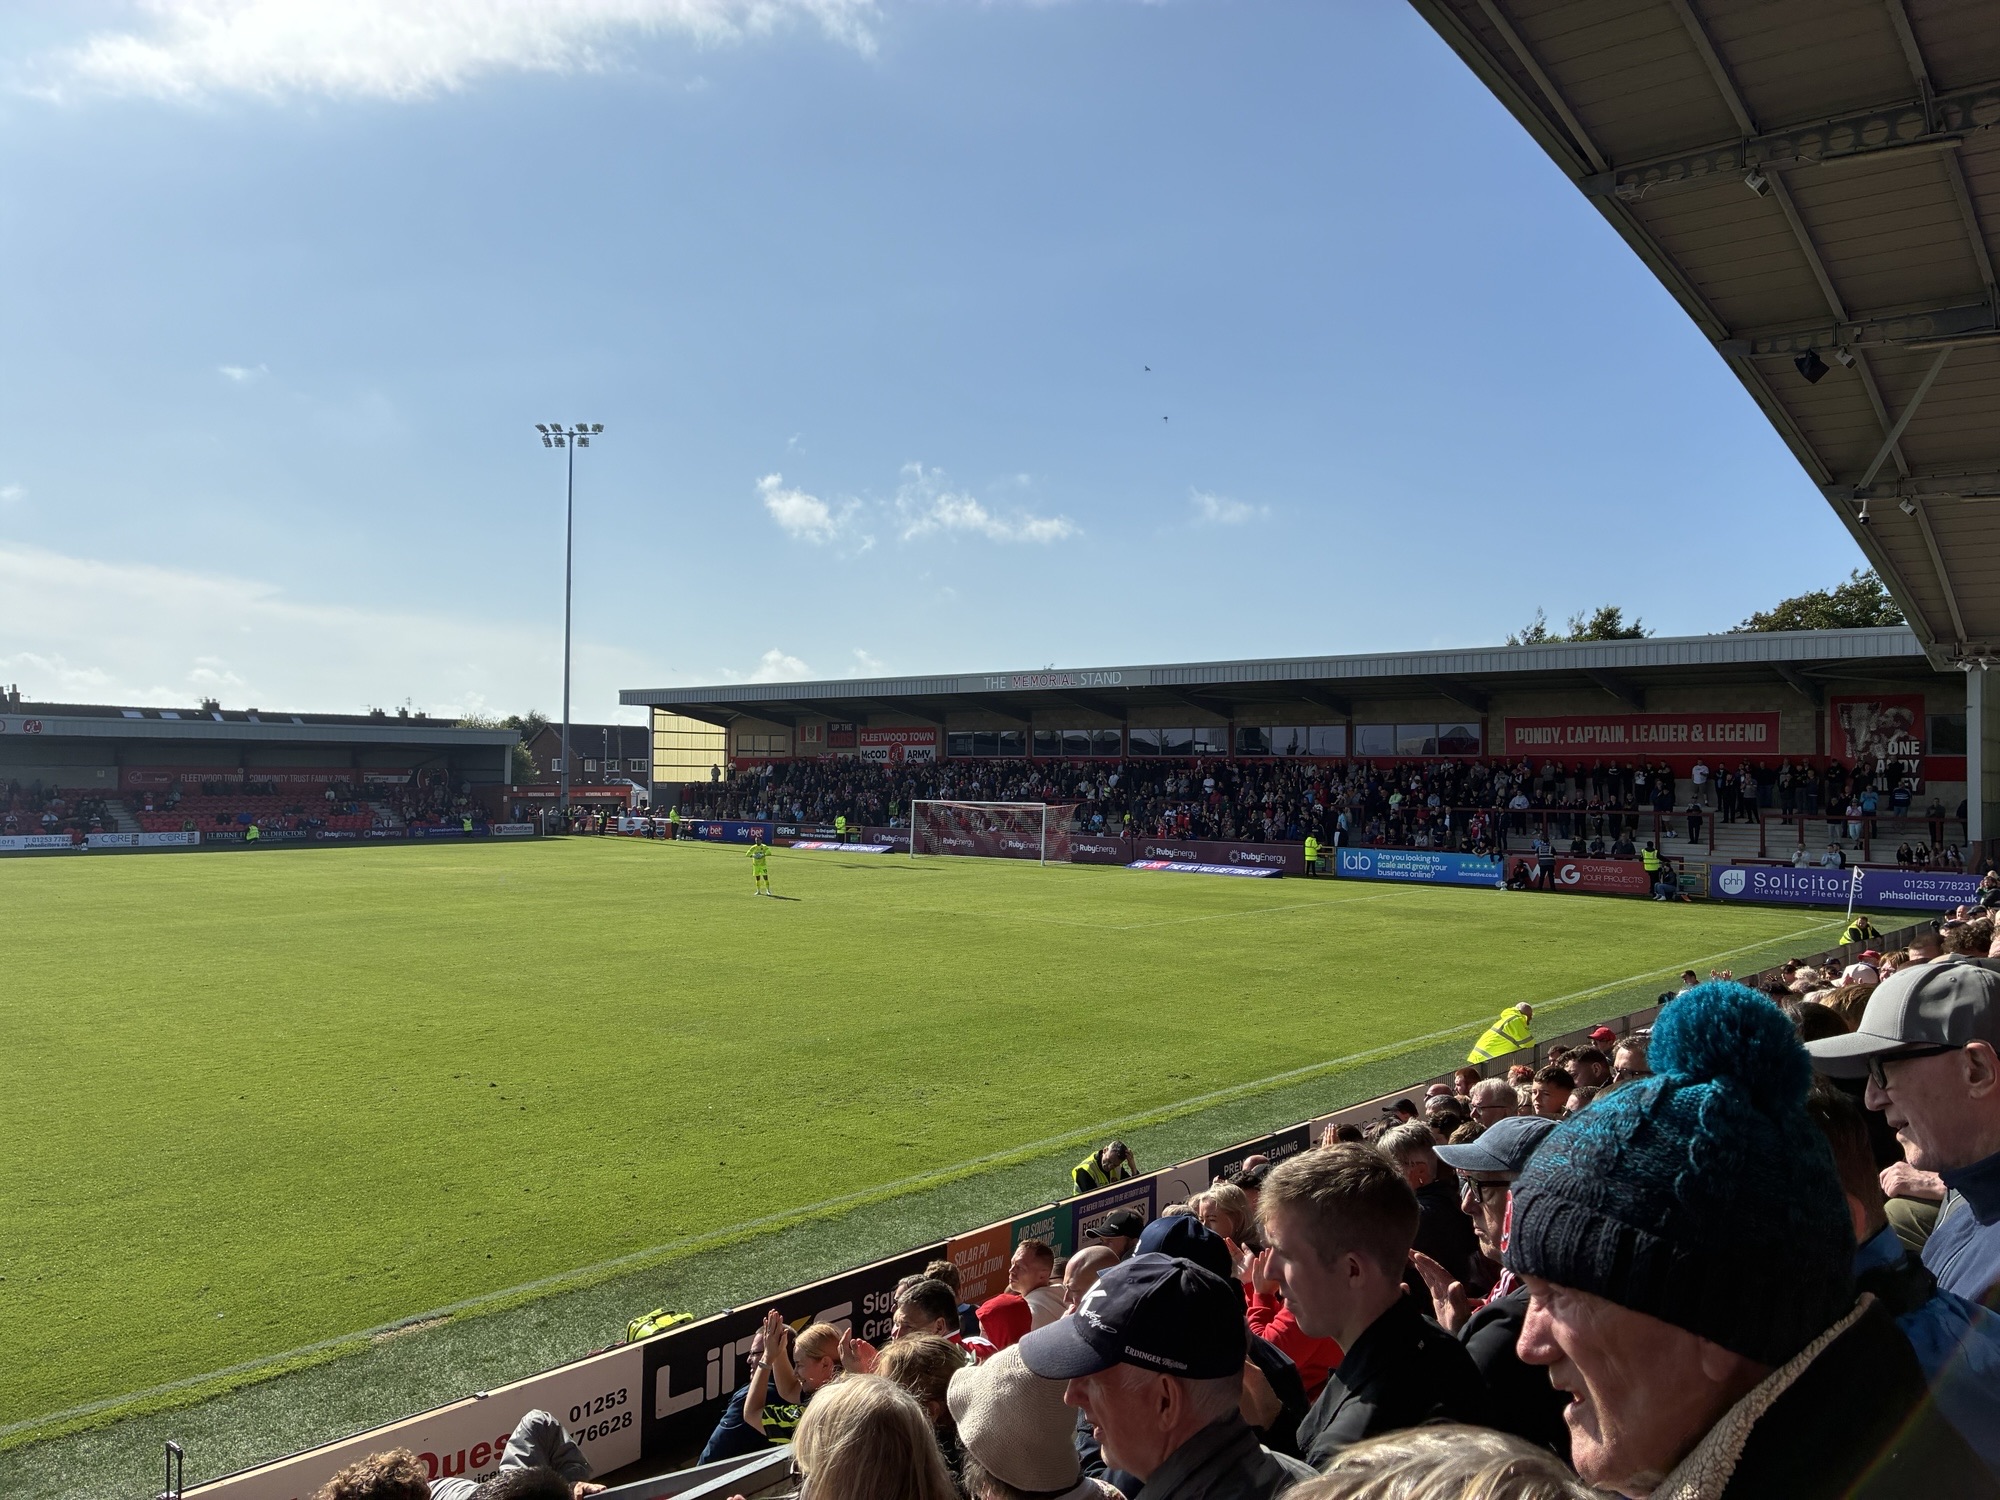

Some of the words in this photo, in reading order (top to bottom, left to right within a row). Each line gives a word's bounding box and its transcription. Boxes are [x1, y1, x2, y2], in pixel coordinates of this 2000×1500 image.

[984, 677, 1006, 689] THE
[1012, 673, 1077, 688] MEMORIAL
[1080, 671, 1122, 686] STAND
[831, 723, 839, 731] UP
[841, 723, 853, 731] THE
[861, 733, 908, 742] FLEETWOOD
[909, 732, 934, 741] TOWN
[1515, 727, 1564, 745] PONDY,
[1567, 725, 1629, 744] CAPTAIN,
[1632, 724, 1688, 743] LEADER
[1690, 724, 1705, 742] &
[1707, 723, 1767, 742] LEGEND
[861, 750, 887, 759] McCOD
[907, 750, 931, 759] ARMY
[1887, 741, 1920, 755] ONE
[1875, 759, 1920, 773] ADY
[180, 773, 221, 783] FLEETWOOD
[224, 773, 244, 783] TOWN
[249, 774, 290, 783] COMMUNITY
[290, 774, 310, 783] TRUST
[311, 774, 333, 783] FAMILY
[334, 774, 351, 783] ZONE
[698, 825, 709, 836] sky
[709, 825, 722, 835] bet
[737, 826, 750, 838] sky
[750, 827, 763, 837] bet
[1079, 844, 1118, 855] RubyEnergy
[1156, 847, 1198, 860] RubyEnergy
[1241, 852, 1287, 866] RubyEnergy
[1343, 851, 1371, 871] lab
[1377, 852, 1391, 860] Are
[1390, 853, 1405, 862] you
[1405, 853, 1431, 864] looking
[1432, 855, 1440, 863] to
[1377, 861, 1396, 869] scale
[1397, 862, 1411, 870] and
[1411, 864, 1430, 873] grow
[1430, 864, 1448, 874] your
[1377, 868, 1409, 878] business
[1409, 870, 1435, 879] online?
[1582, 865, 1623, 874] POWERING
[1603, 875, 1644, 884] PROJECTS
[1723, 872, 1743, 890] phh
[1753, 872, 1863, 893] Solicitors
[1903, 879, 1936, 890] 01253
[1938, 881, 1976, 891] 778231
[1754, 887, 1800, 897] Cleveleys
[1879, 890, 1978, 903] phhsolicitors.co.uk
[1018, 1225, 1030, 1241] AIR
[1030, 1216, 1056, 1237] SOURCE
[954, 1246, 978, 1267] SOLAR
[979, 1241, 991, 1258] PV
[1124, 1345, 1162, 1365] ERDINGER
[569, 1387, 628, 1423] 01253
[570, 1411, 633, 1447] 76628
